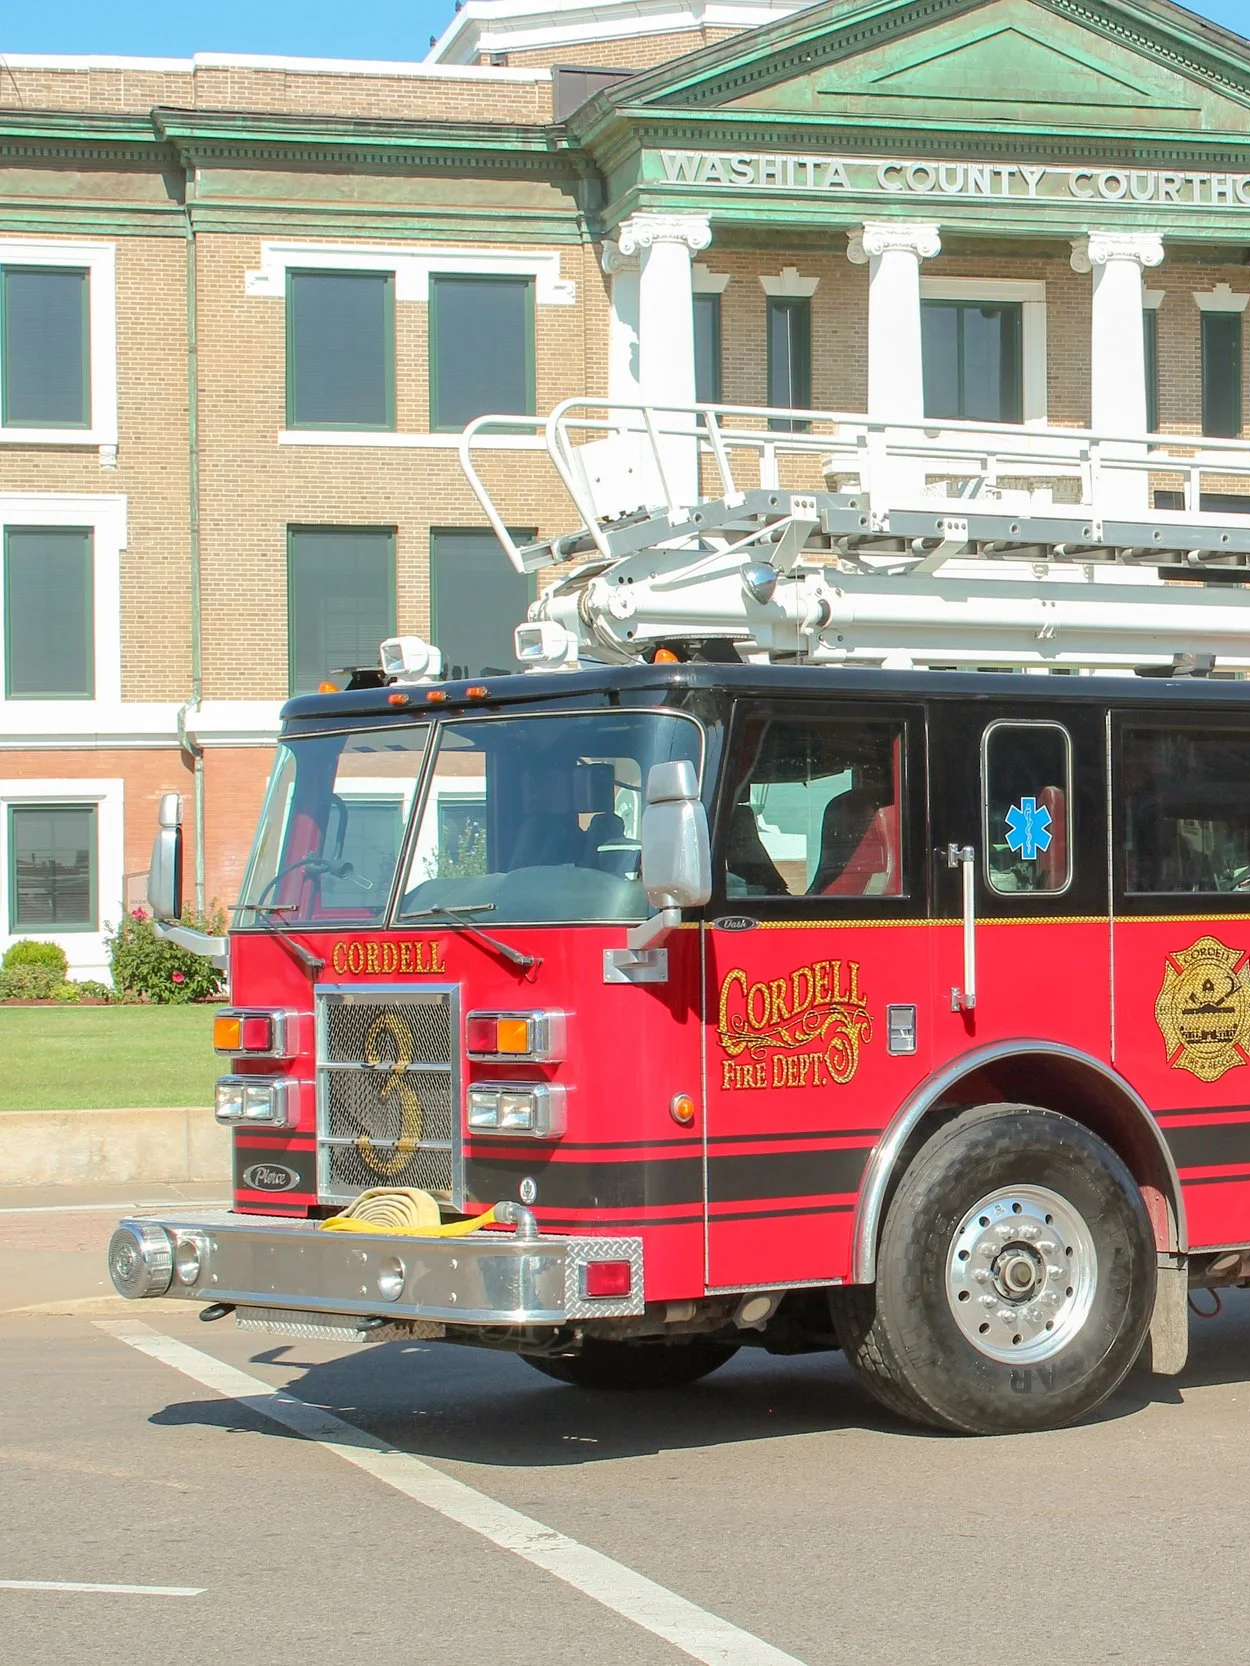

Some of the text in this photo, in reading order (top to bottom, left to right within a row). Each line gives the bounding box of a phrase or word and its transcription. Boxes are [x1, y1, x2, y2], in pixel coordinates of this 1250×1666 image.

[660, 150, 852, 190] WASHITA
[877, 160, 1045, 199] COUNTY
[723, 919, 747, 929] Dash
[332, 940, 446, 975] CORDELL
[1183, 946, 1231, 964] CORDELL
[718, 958, 868, 1057] CORDELL
[720, 1051, 828, 1091] FIRE DEPT.
[355, 1012, 424, 1177] 3
[255, 1166, 286, 1186] Pierce
